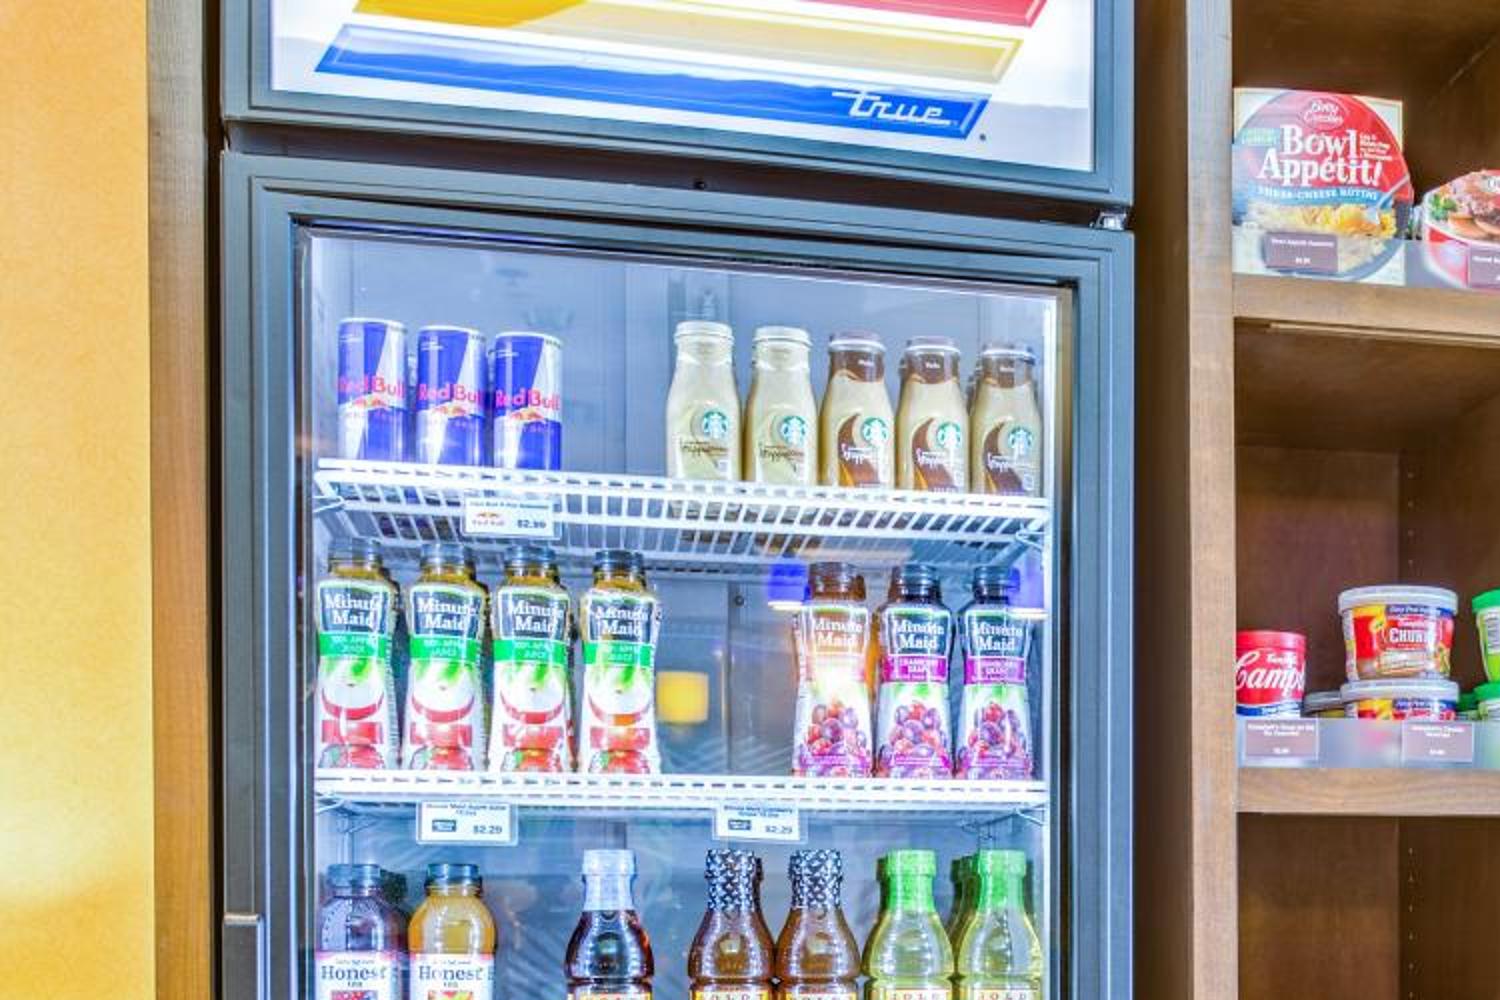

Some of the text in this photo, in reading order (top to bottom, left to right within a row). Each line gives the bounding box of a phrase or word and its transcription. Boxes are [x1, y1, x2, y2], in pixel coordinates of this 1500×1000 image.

[1279, 124, 1358, 159] Bowl
[527, 389, 561, 411] Bull
[417, 596, 478, 616] Minute
[508, 599, 564, 620] Minute
[332, 609, 375, 630] Maid
[424, 613, 465, 632] Maid
[514, 614, 557, 633] Maid
[601, 617, 642, 637] Maid
[900, 633, 939, 650] Maid
[978, 634, 1016, 650] Maid
[321, 965, 387, 982] Honest
[419, 964, 483, 982] Honest
